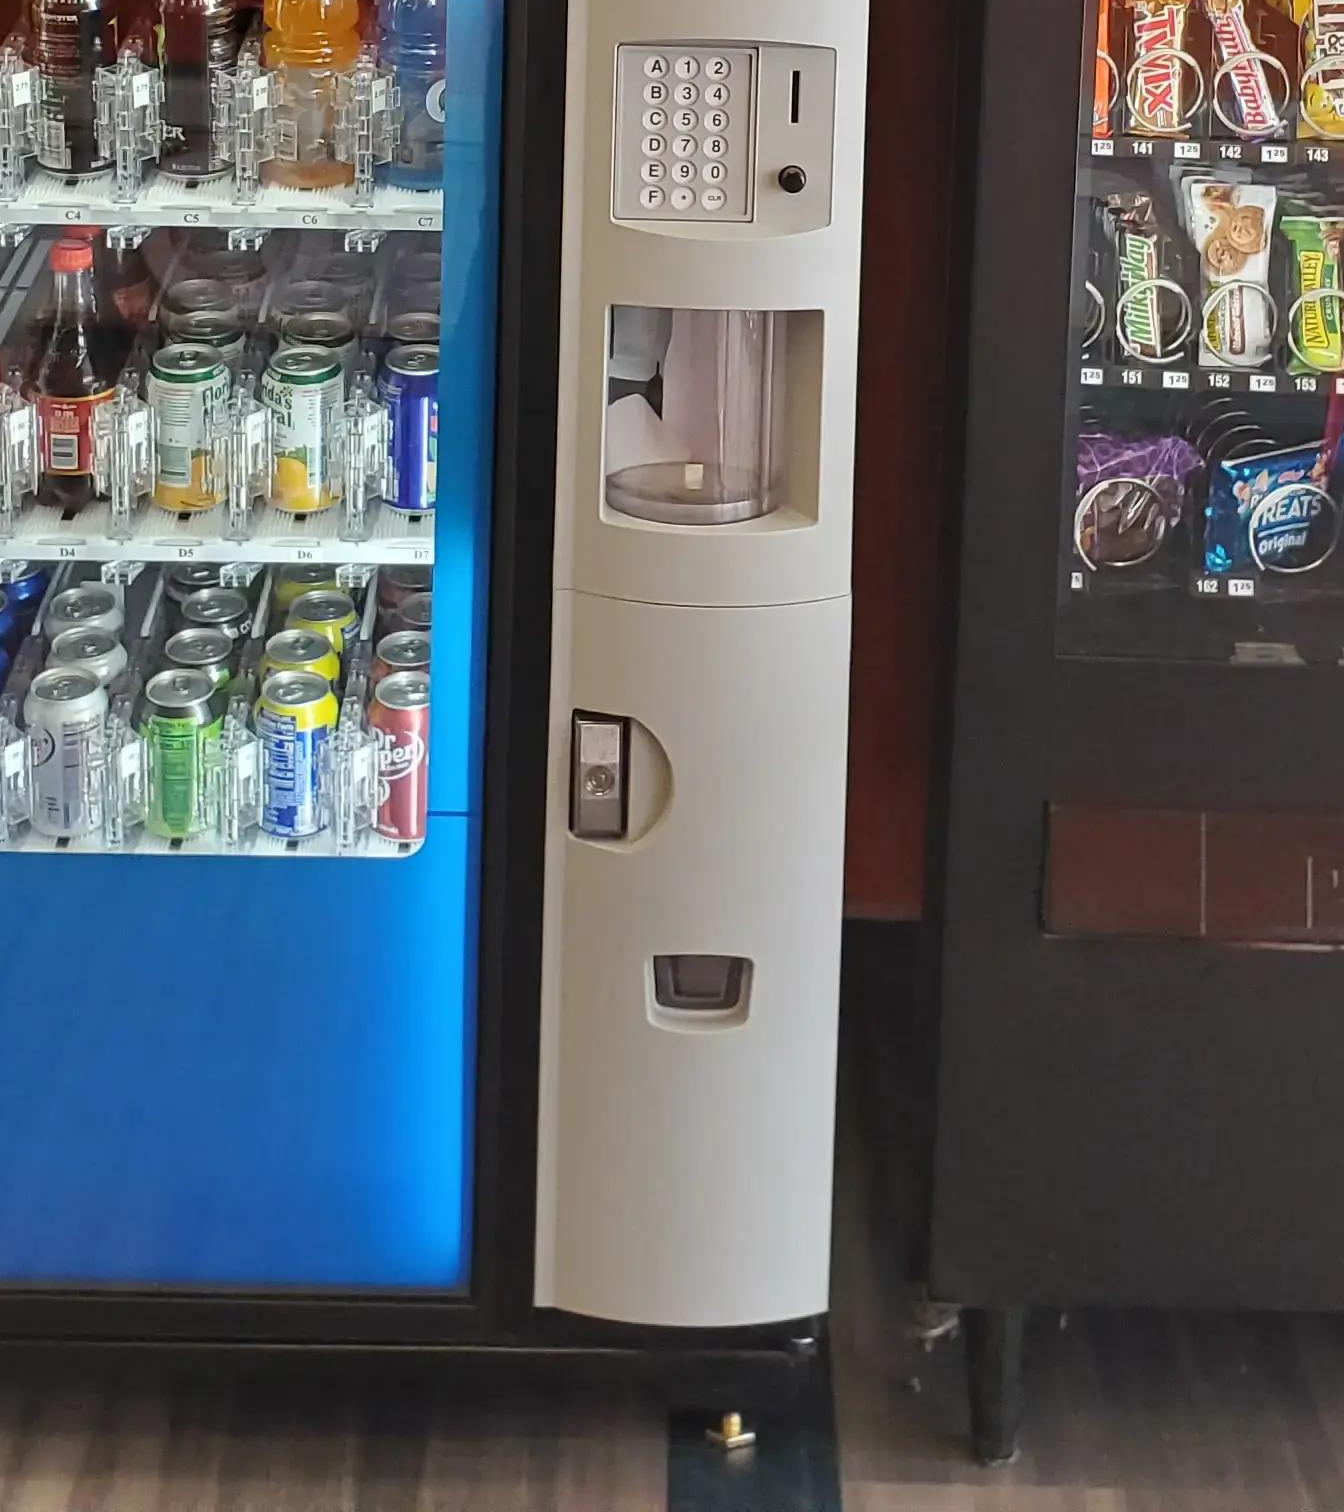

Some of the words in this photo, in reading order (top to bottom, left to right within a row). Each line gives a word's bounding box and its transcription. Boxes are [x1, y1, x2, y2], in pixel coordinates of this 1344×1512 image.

[651, 60, 663, 73] A
[684, 61, 691, 73] 1
[714, 62, 723, 74] 2
[1134, 7, 1177, 117] TWIX
[651, 86, 662, 99] B
[682, 87, 692, 100] 3
[713, 88, 722, 100] 4
[649, 112, 662, 125] C
[682, 113, 691, 126] 5
[712, 114, 721, 126] 6
[649, 139, 660, 151] D
[681, 139, 690, 152] 7
[712, 140, 721, 153] 8
[1132, 142, 1152, 154] 141
[1219, 146, 1242, 158] 142
[1306, 150, 1328, 161] 143
[649, 165, 659, 177] E
[680, 165, 689, 178] 9
[711, 166, 720, 179] 0
[648, 191, 658, 203] F
[65, 210, 81, 221] C4
[183, 213, 201, 224] C5
[301, 214, 318, 225] C6
[417, 216, 434, 228] C7
[1120, 236, 1153, 288] Way
[1303, 255, 1323, 294] ALLEY
[1122, 291, 1154, 346] Milky
[1121, 371, 1143, 384] 151
[1207, 375, 1230, 387] 152
[1258, 531, 1307, 555] Original
[59, 547, 76, 559] D4
[178, 548, 194, 559] D5
[297, 549, 313, 561] D6
[414, 549, 430, 561] D7
